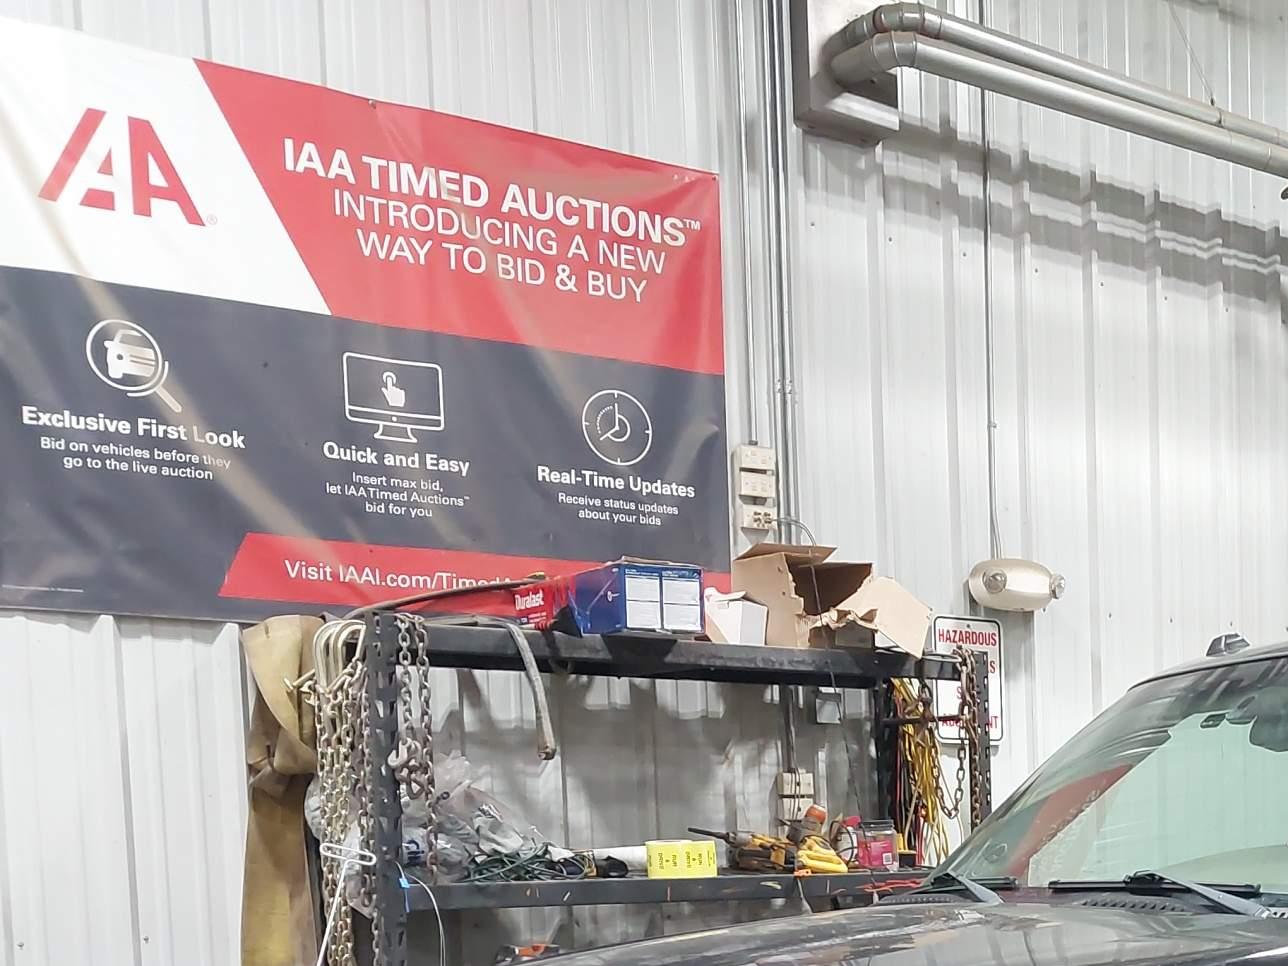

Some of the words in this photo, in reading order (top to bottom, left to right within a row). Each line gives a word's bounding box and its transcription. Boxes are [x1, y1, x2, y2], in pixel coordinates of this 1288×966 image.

[283, 138, 356, 183] IAA
[361, 155, 489, 207] TIMED
[334, 188, 556, 256] INTRODUCING
[567, 234, 590, 261] A
[598, 240, 667, 275] NEW
[356, 229, 433, 265] WAY
[443, 244, 487, 275] TO
[497, 253, 545, 286] BID
[555, 264, 577, 291] &
[587, 274, 647, 303] BUY
[21, 406, 131, 436] Exclusive
[138, 418, 188, 441] First
[193, 426, 246, 449] Look
[40, 436, 65, 451] Bid
[69, 441, 89, 453] on
[92, 442, 150, 460] vehicles
[154, 447, 199, 464] before
[202, 452, 231, 470] they
[323, 441, 378, 465] Quick
[383, 449, 421, 469] and
[426, 454, 470, 476] Easy
[63, 457, 83, 472] go
[87, 457, 101, 470] to
[105, 458, 129, 472] the
[132, 461, 157, 474] live
[161, 465, 214, 481] auction
[326, 482, 342, 496] let
[352, 472, 387, 487] Insert
[390, 478, 417, 491] max
[537, 466, 625, 489] Real-Time
[629, 475, 696, 499] Updates
[365, 502, 385, 516] bid
[388, 503, 407, 517] for
[409, 507, 433, 519] you
[558, 493, 601, 508] Receive
[603, 497, 636, 511] status
[638, 501, 679, 515] updates
[578, 508, 610, 521] about
[612, 512, 637, 525] your
[639, 514, 661, 526] bids
[284, 559, 332, 581] Visit
[514, 588, 545, 611] Duralast
[938, 629, 997, 646] HAZARDOUS
